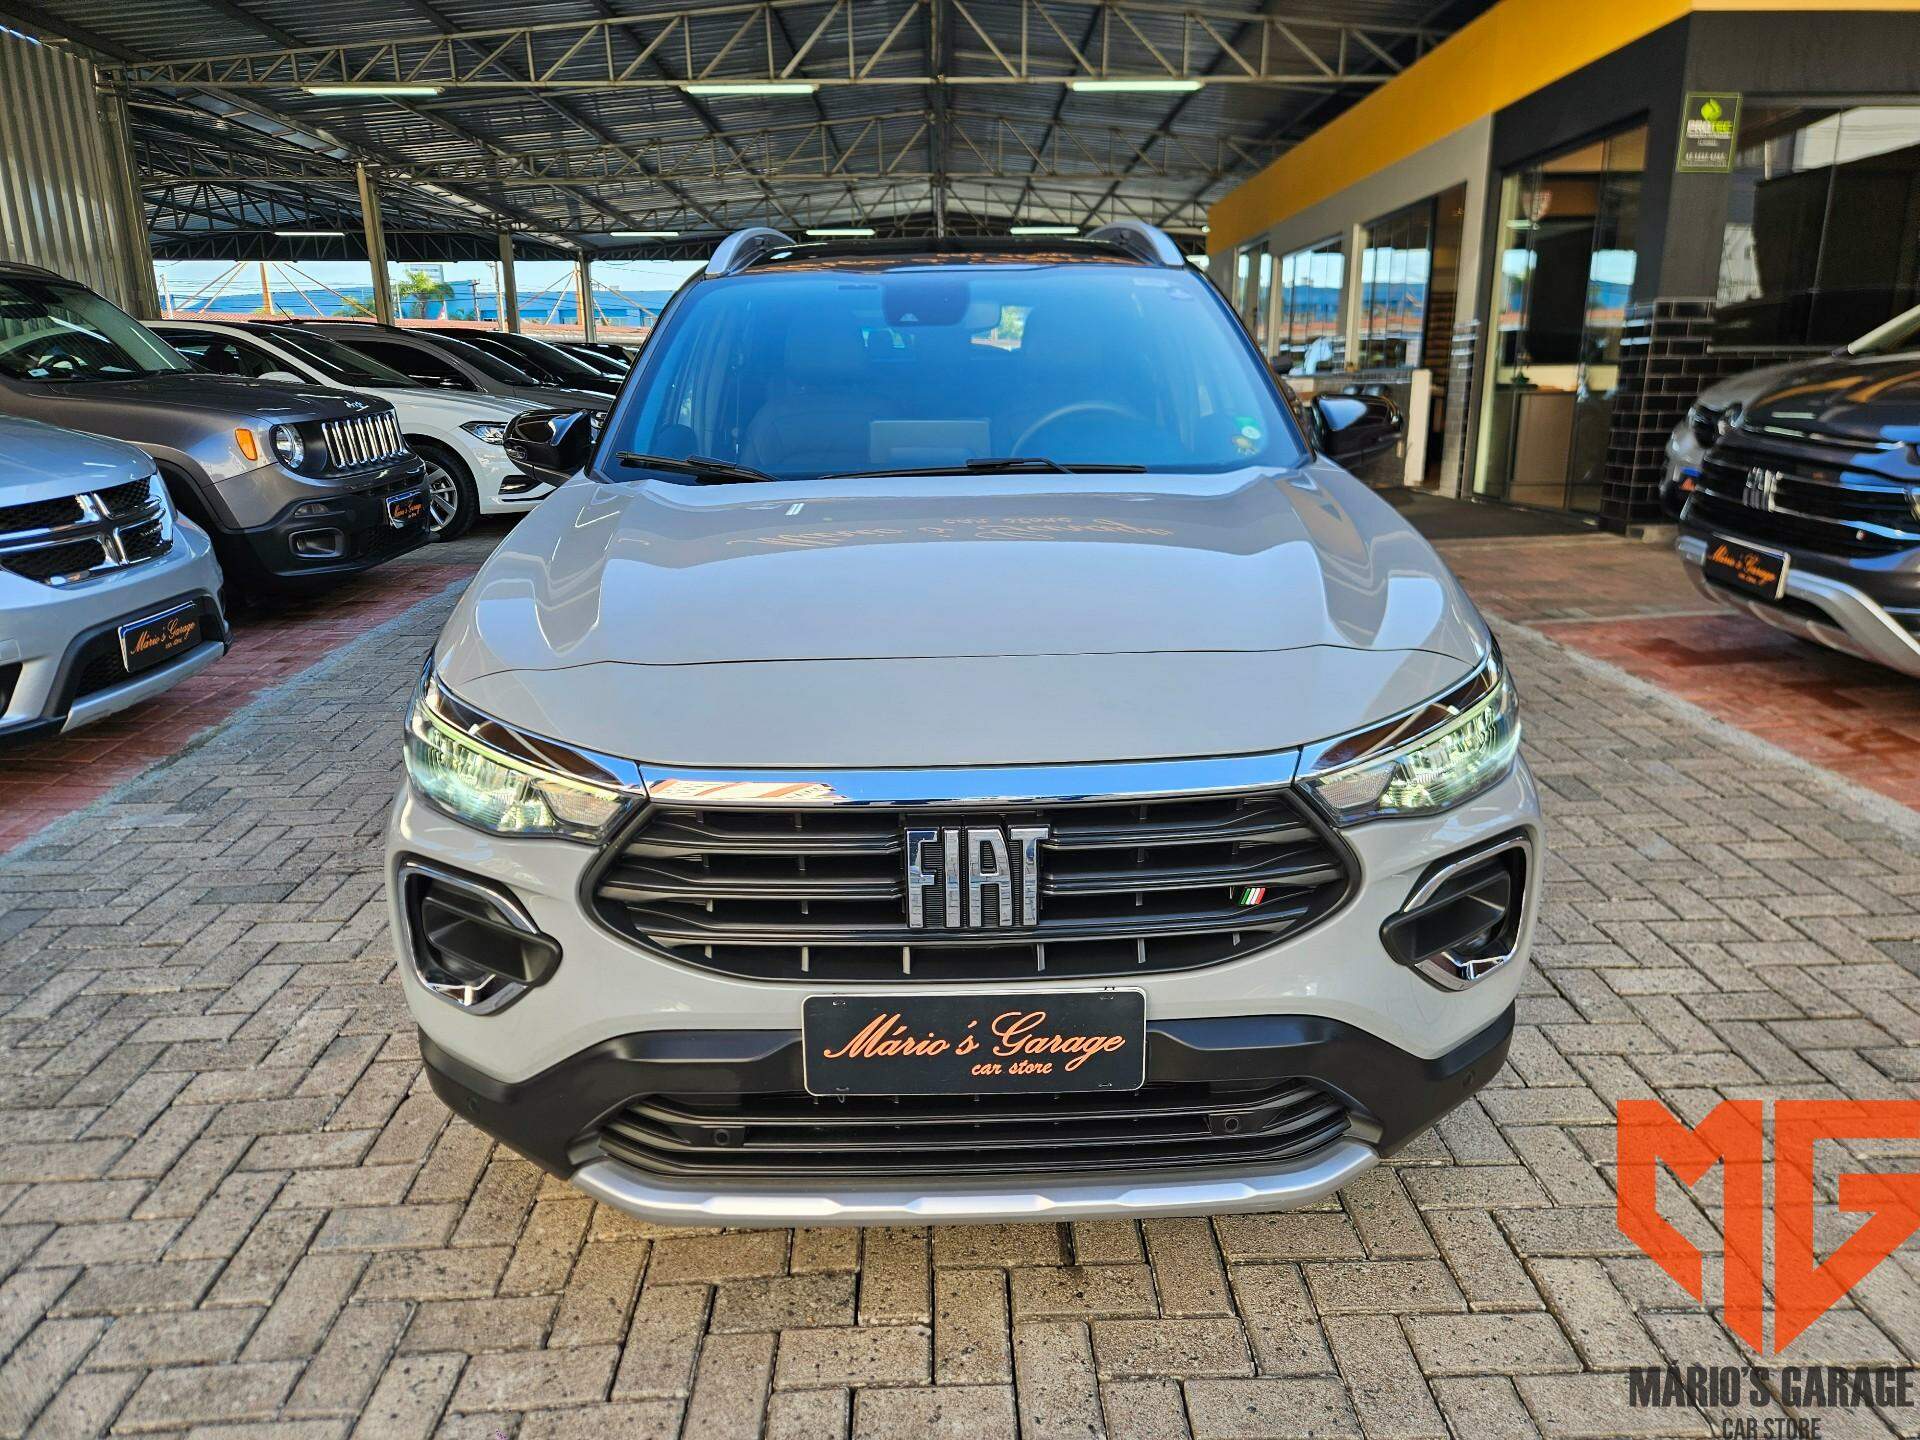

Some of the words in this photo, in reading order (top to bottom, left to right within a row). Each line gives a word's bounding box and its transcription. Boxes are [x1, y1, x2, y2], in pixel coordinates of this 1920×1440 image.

[905, 826, 1050, 928] FIAT
[971, 1063, 1001, 1076] car
[1008, 1059, 1053, 1075] store
[991, 1011, 1126, 1072] Garage
